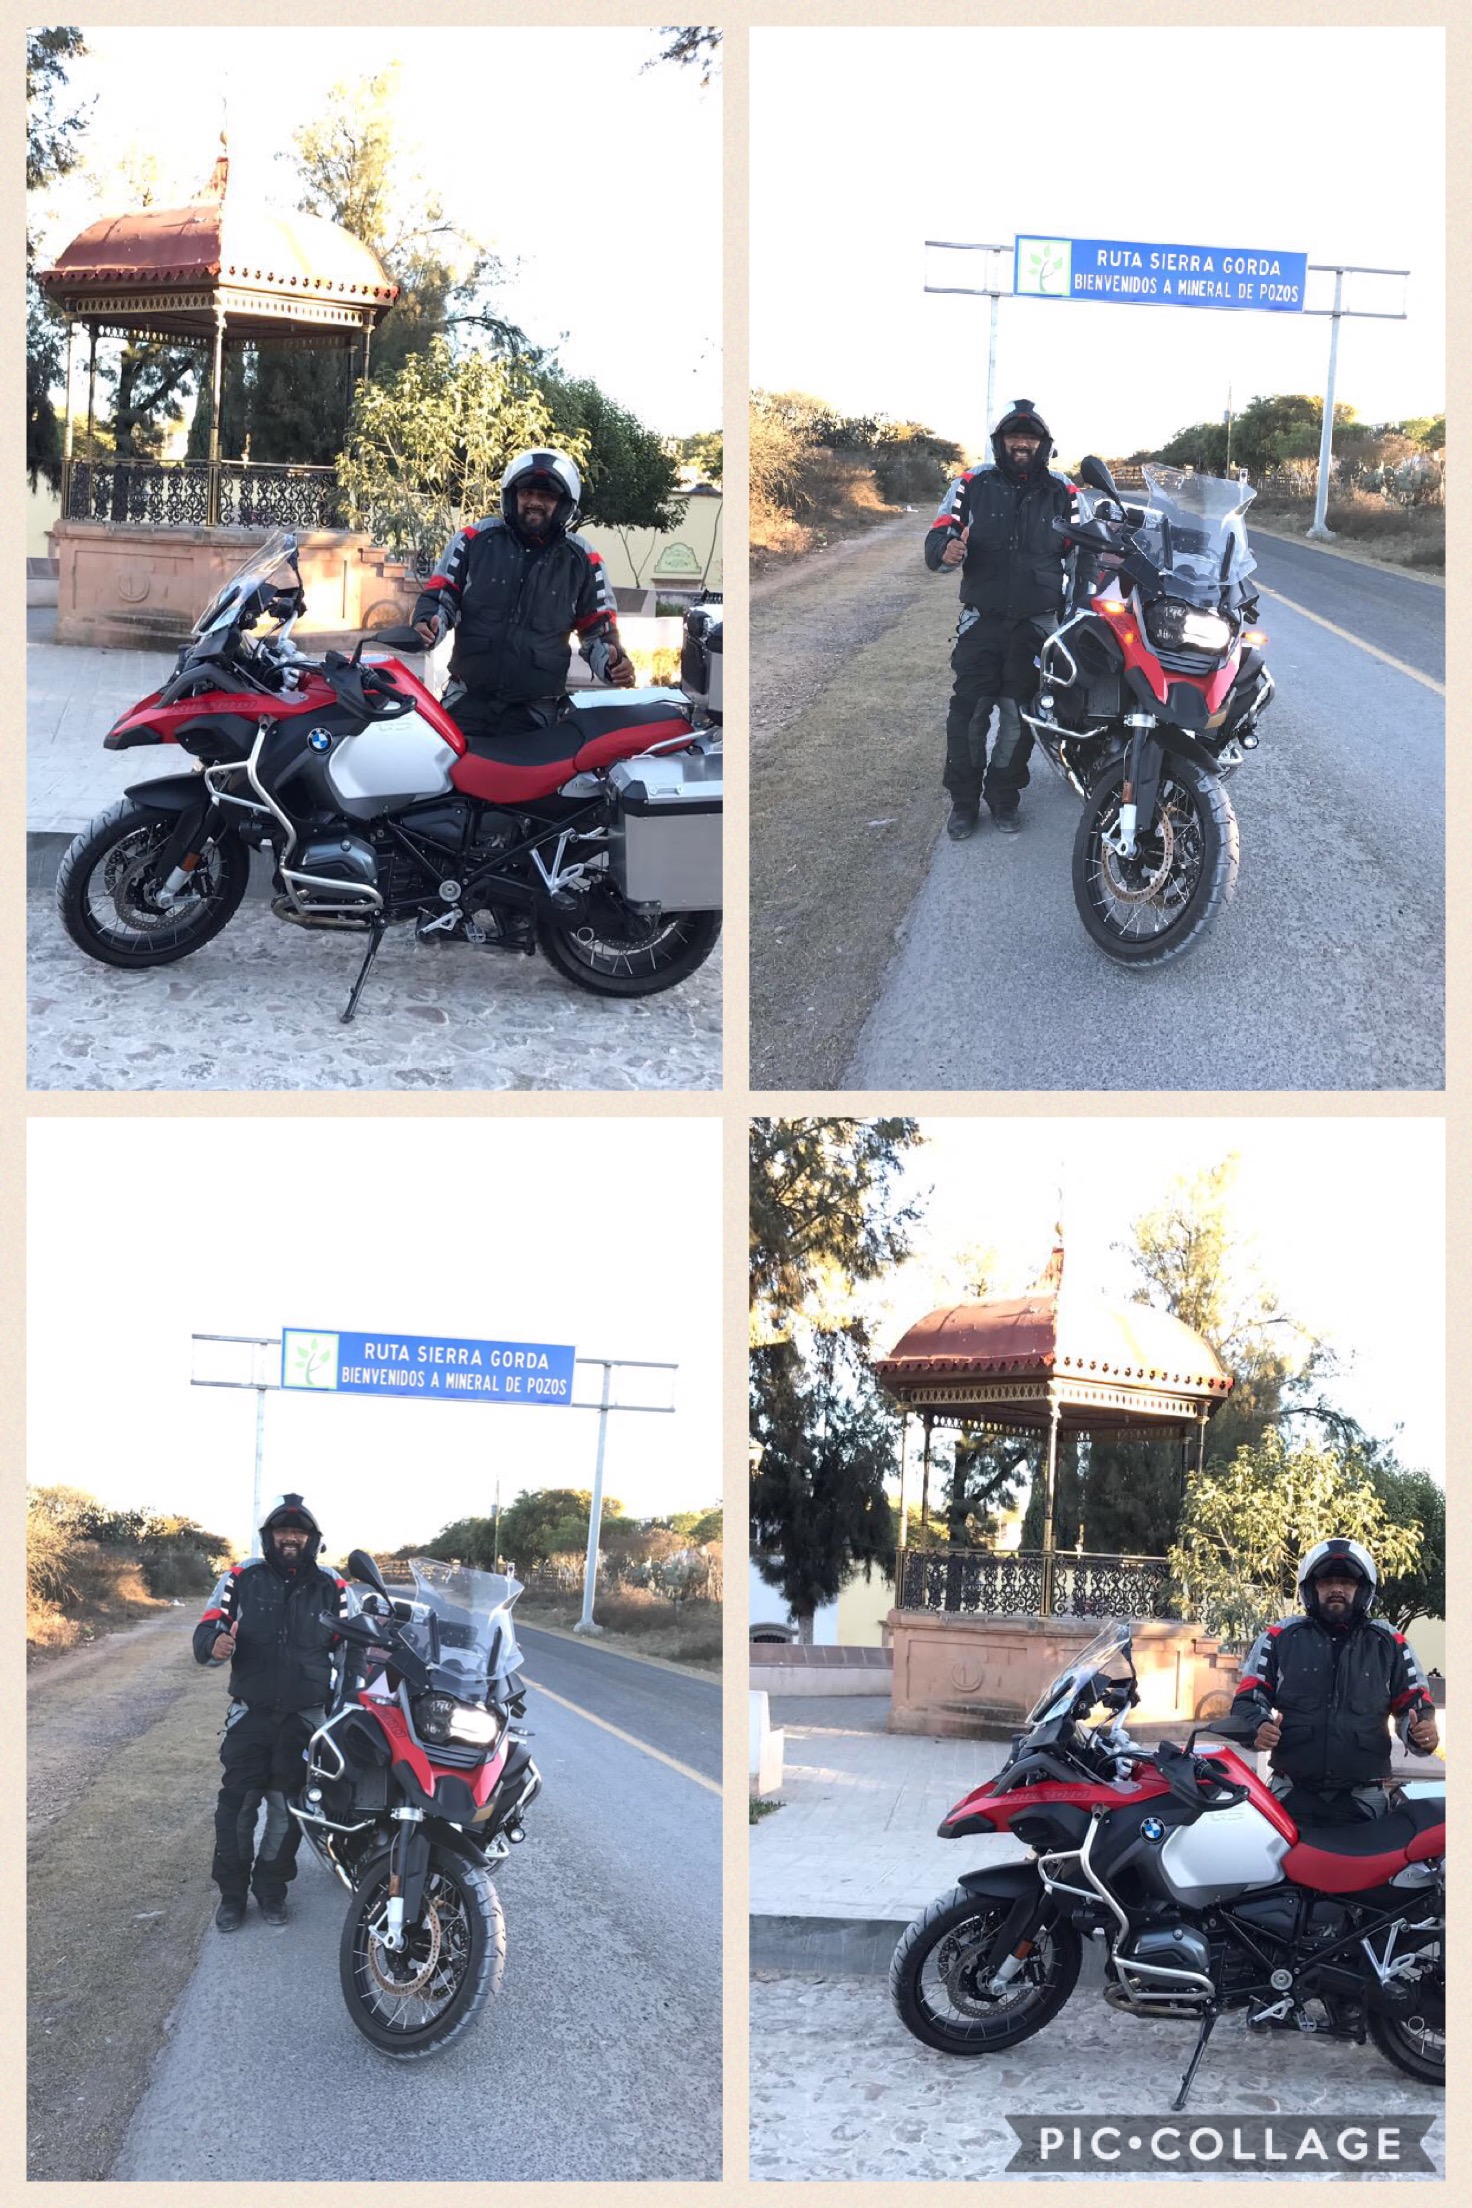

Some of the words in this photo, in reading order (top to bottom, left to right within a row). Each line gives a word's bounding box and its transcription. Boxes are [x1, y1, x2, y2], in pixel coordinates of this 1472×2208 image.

[1097, 249, 1142, 267] RUTA
[1150, 252, 1214, 272] SIERRA
[1223, 256, 1280, 276] GORDA
[1074, 273, 1157, 295] BIENVENIDOS
[1164, 278, 1172, 294] A
[1178, 279, 1232, 298] MINERAL
[1238, 283, 1254, 300] DE
[1260, 283, 1299, 303] POZOS
[365, 1343, 409, 1361] RUTA
[417, 1345, 482, 1366] SIERRA
[490, 1350, 548, 1370] GORDA
[342, 1366, 424, 1388] BIENVENIDOS
[431, 1371, 439, 1387] A
[446, 1372, 499, 1391] MINERAL
[506, 1375, 522, 1393] DE
[527, 1377, 567, 1396] POZOS
